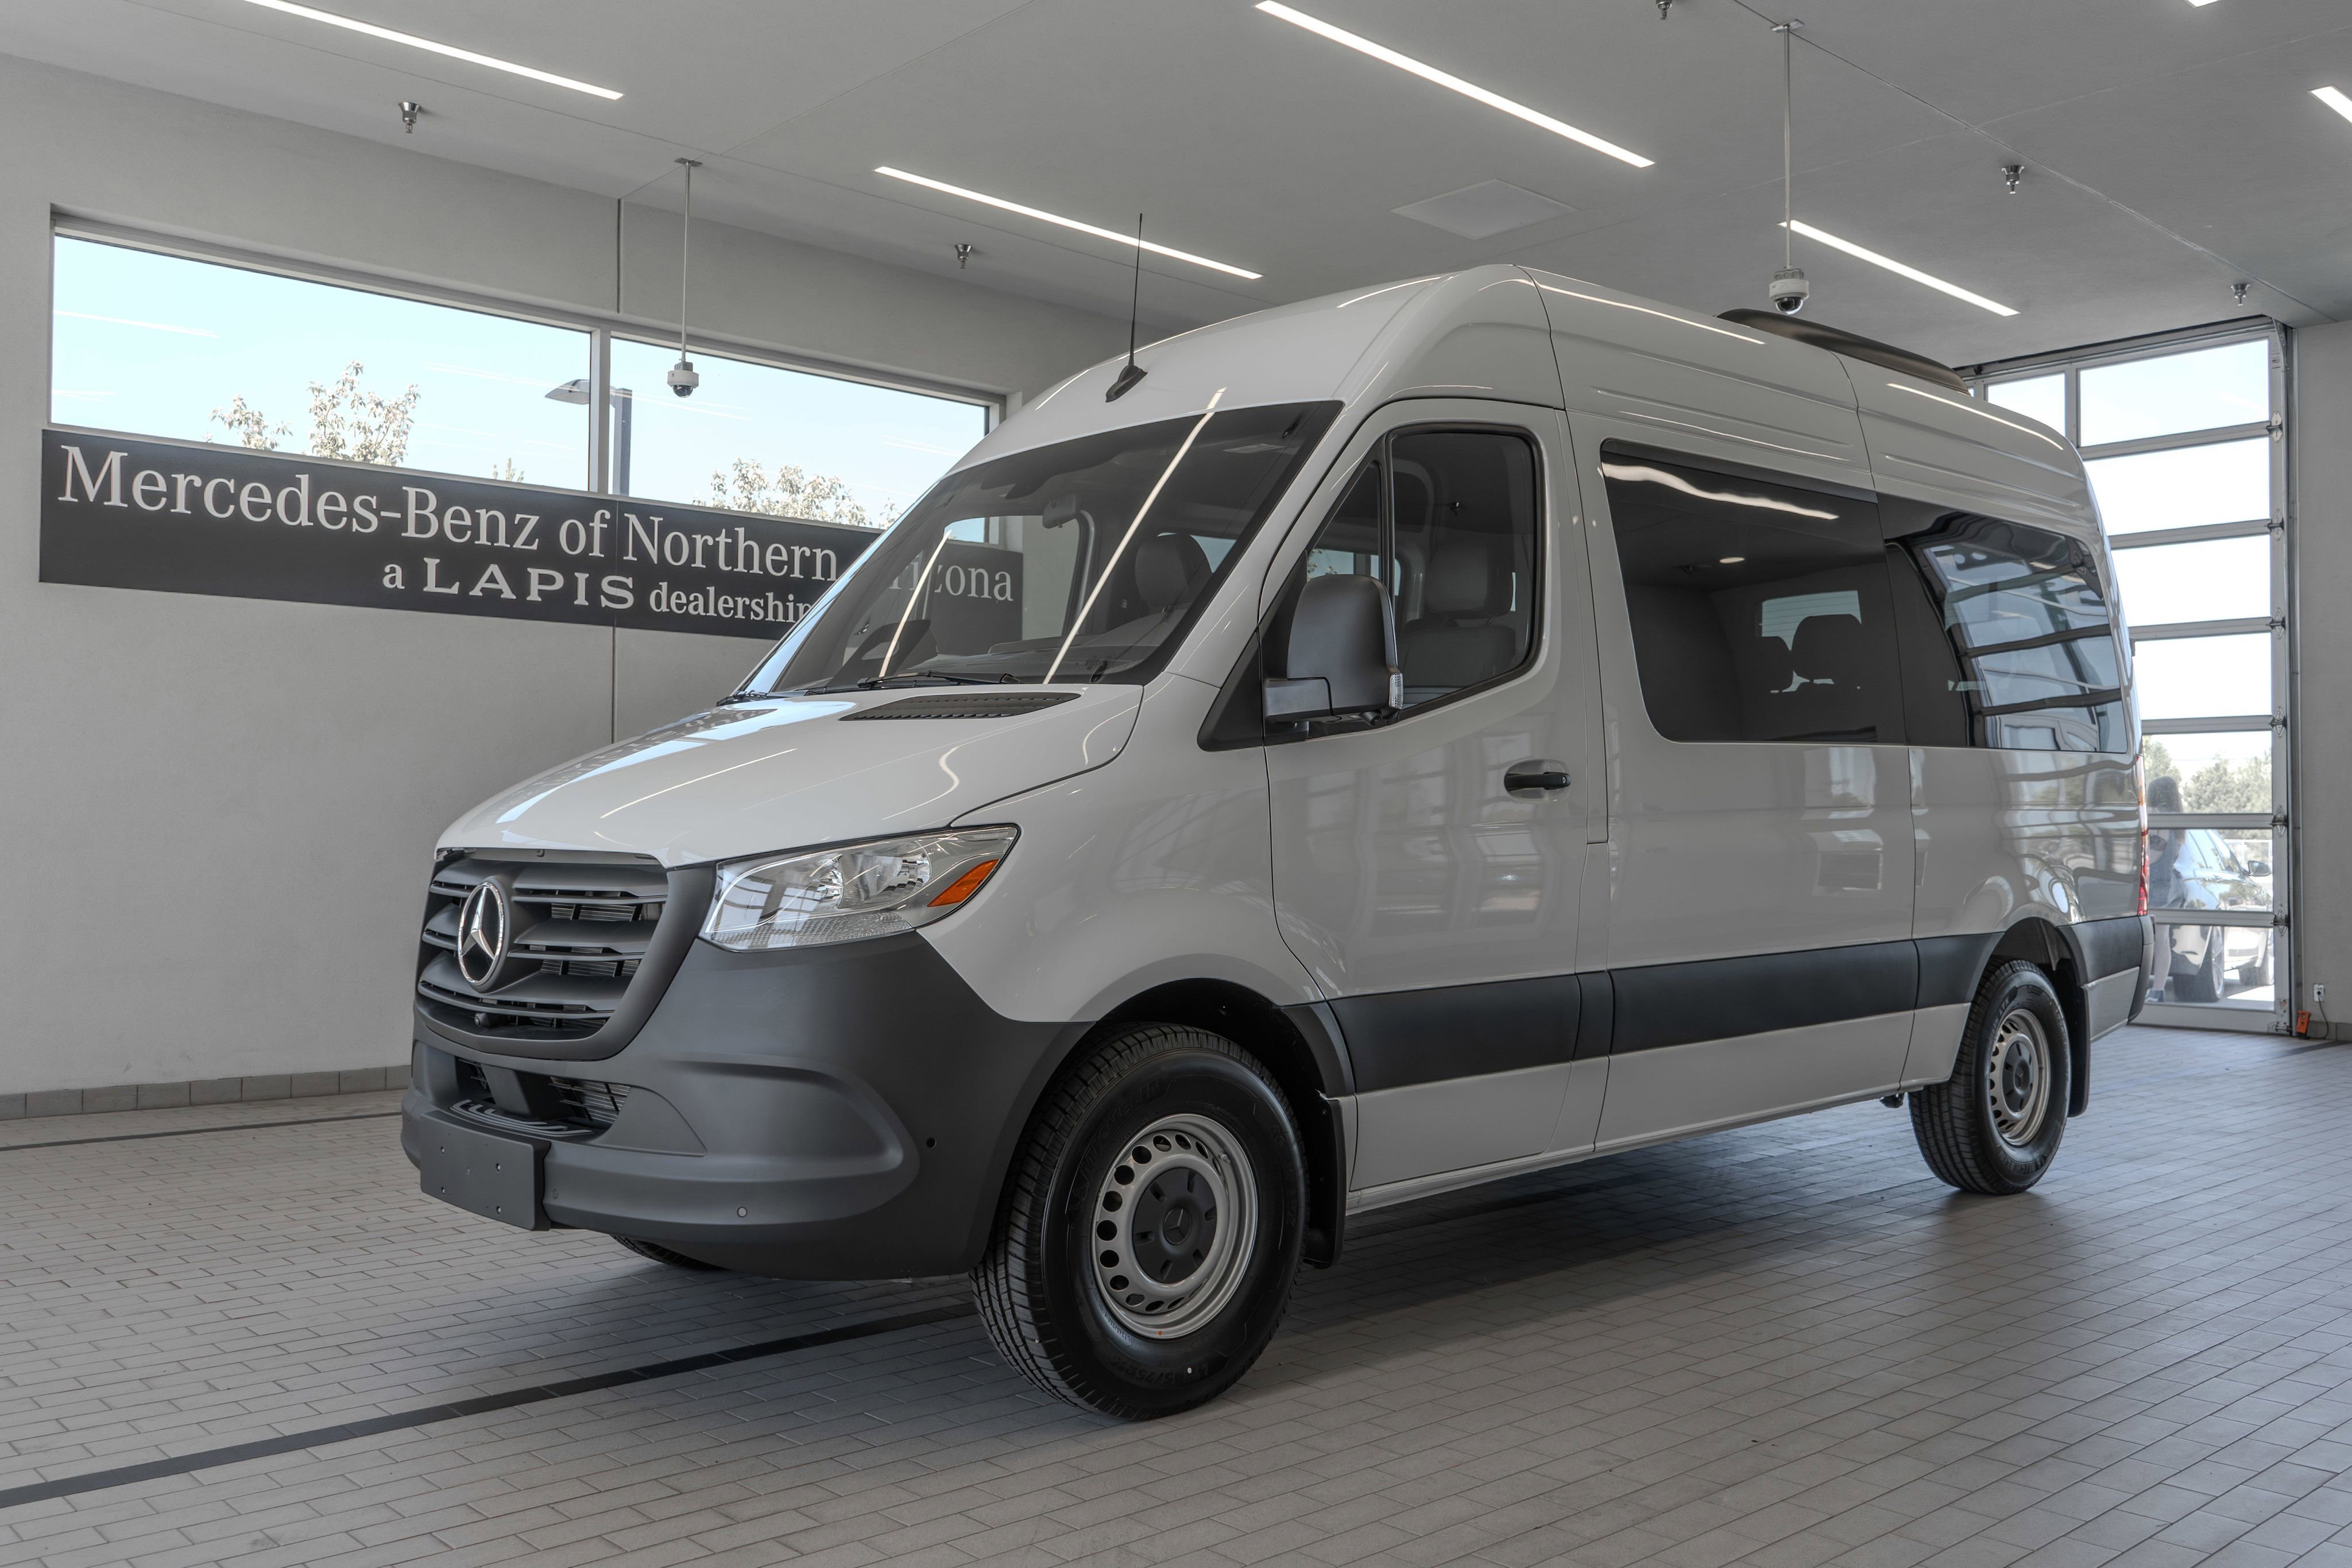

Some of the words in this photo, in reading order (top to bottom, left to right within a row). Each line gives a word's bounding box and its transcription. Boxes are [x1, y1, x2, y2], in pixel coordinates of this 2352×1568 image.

[57, 445, 539, 551] Mercedes-Benz
[559, 509, 611, 558] of
[623, 512, 838, 582] Northern
[382, 563, 405, 590] a
[423, 557, 635, 609] LAPIS
